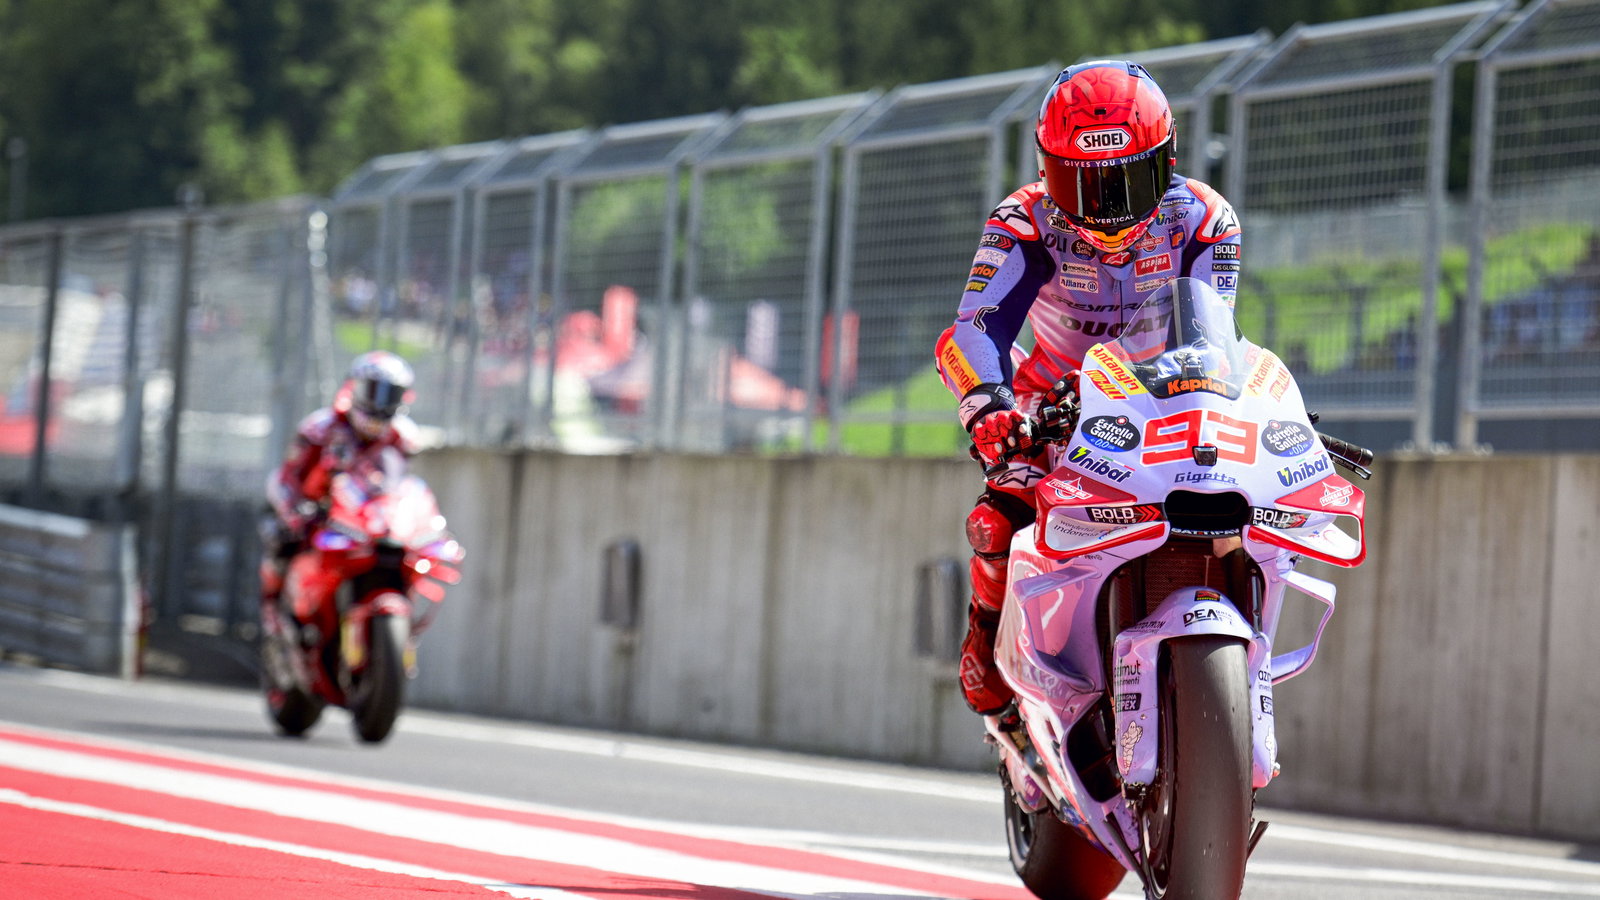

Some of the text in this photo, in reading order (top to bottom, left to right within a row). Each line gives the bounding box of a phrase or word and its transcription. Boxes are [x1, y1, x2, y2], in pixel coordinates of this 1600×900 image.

[1083, 132, 1124, 148] SHOEI
[1064, 151, 1151, 168] GIVES YOU WINGS
[1095, 214, 1135, 224] VERTICAL
[1156, 210, 1190, 226] Unibat
[1214, 245, 1237, 254] BOLD
[1140, 256, 1168, 270] ASPIRA
[1060, 278, 1087, 289] Allianz
[1060, 311, 1172, 339] DUCAT
[1089, 347, 1140, 391] Antangin
[1167, 377, 1228, 396] Kapriol
[1090, 426, 1126, 447] Galicia
[1094, 418, 1134, 440] Estrella
[1142, 409, 1259, 465] 93
[1266, 425, 1301, 444] Estrella
[1274, 433, 1308, 452] Galicia
[1068, 445, 1132, 483] Unibat
[1276, 453, 1329, 487] Unibat
[1174, 471, 1239, 485] Gigetta
[1091, 507, 1135, 520] BOLD
[1253, 507, 1291, 524] BOLD
[1060, 520, 1096, 533] wonderful
